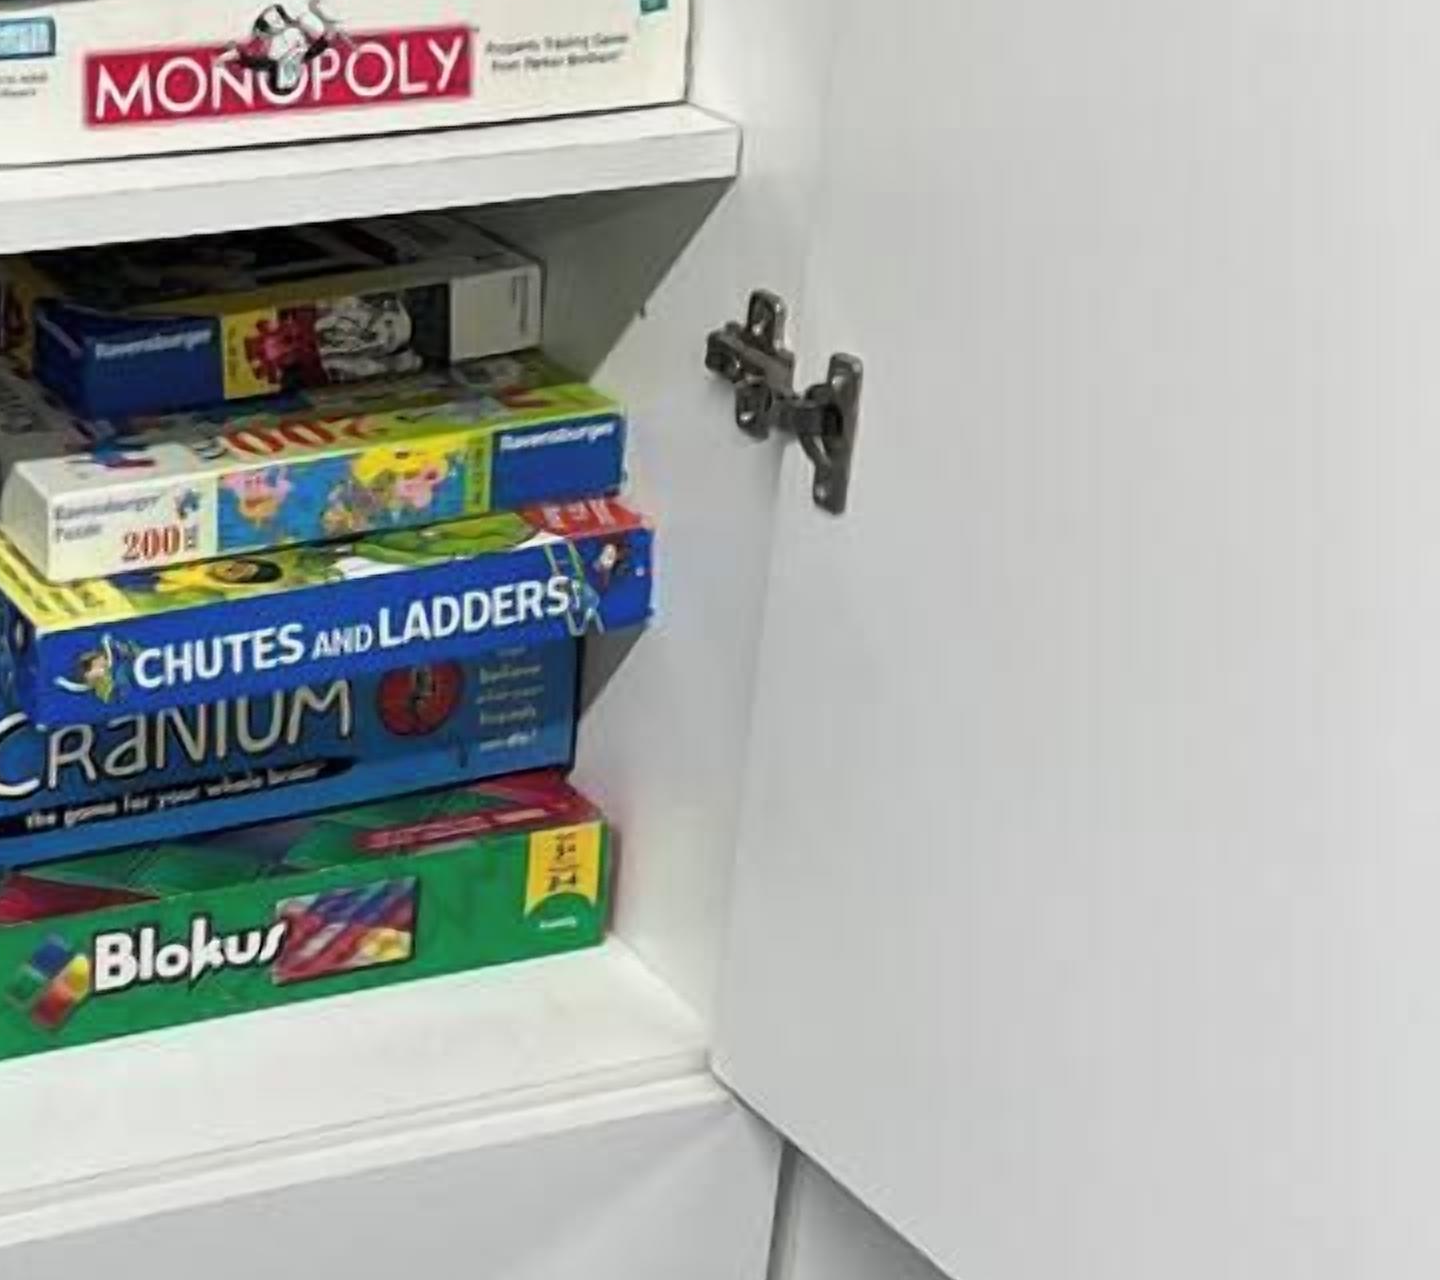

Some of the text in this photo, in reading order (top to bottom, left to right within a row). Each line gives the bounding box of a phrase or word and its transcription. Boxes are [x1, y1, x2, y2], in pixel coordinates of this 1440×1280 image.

[94, 36, 466, 119] MONOPOLY
[121, 523, 182, 563] 200
[131, 576, 571, 689] CHUTES AND LADDERS
[94, 915, 289, 992] Blokus
